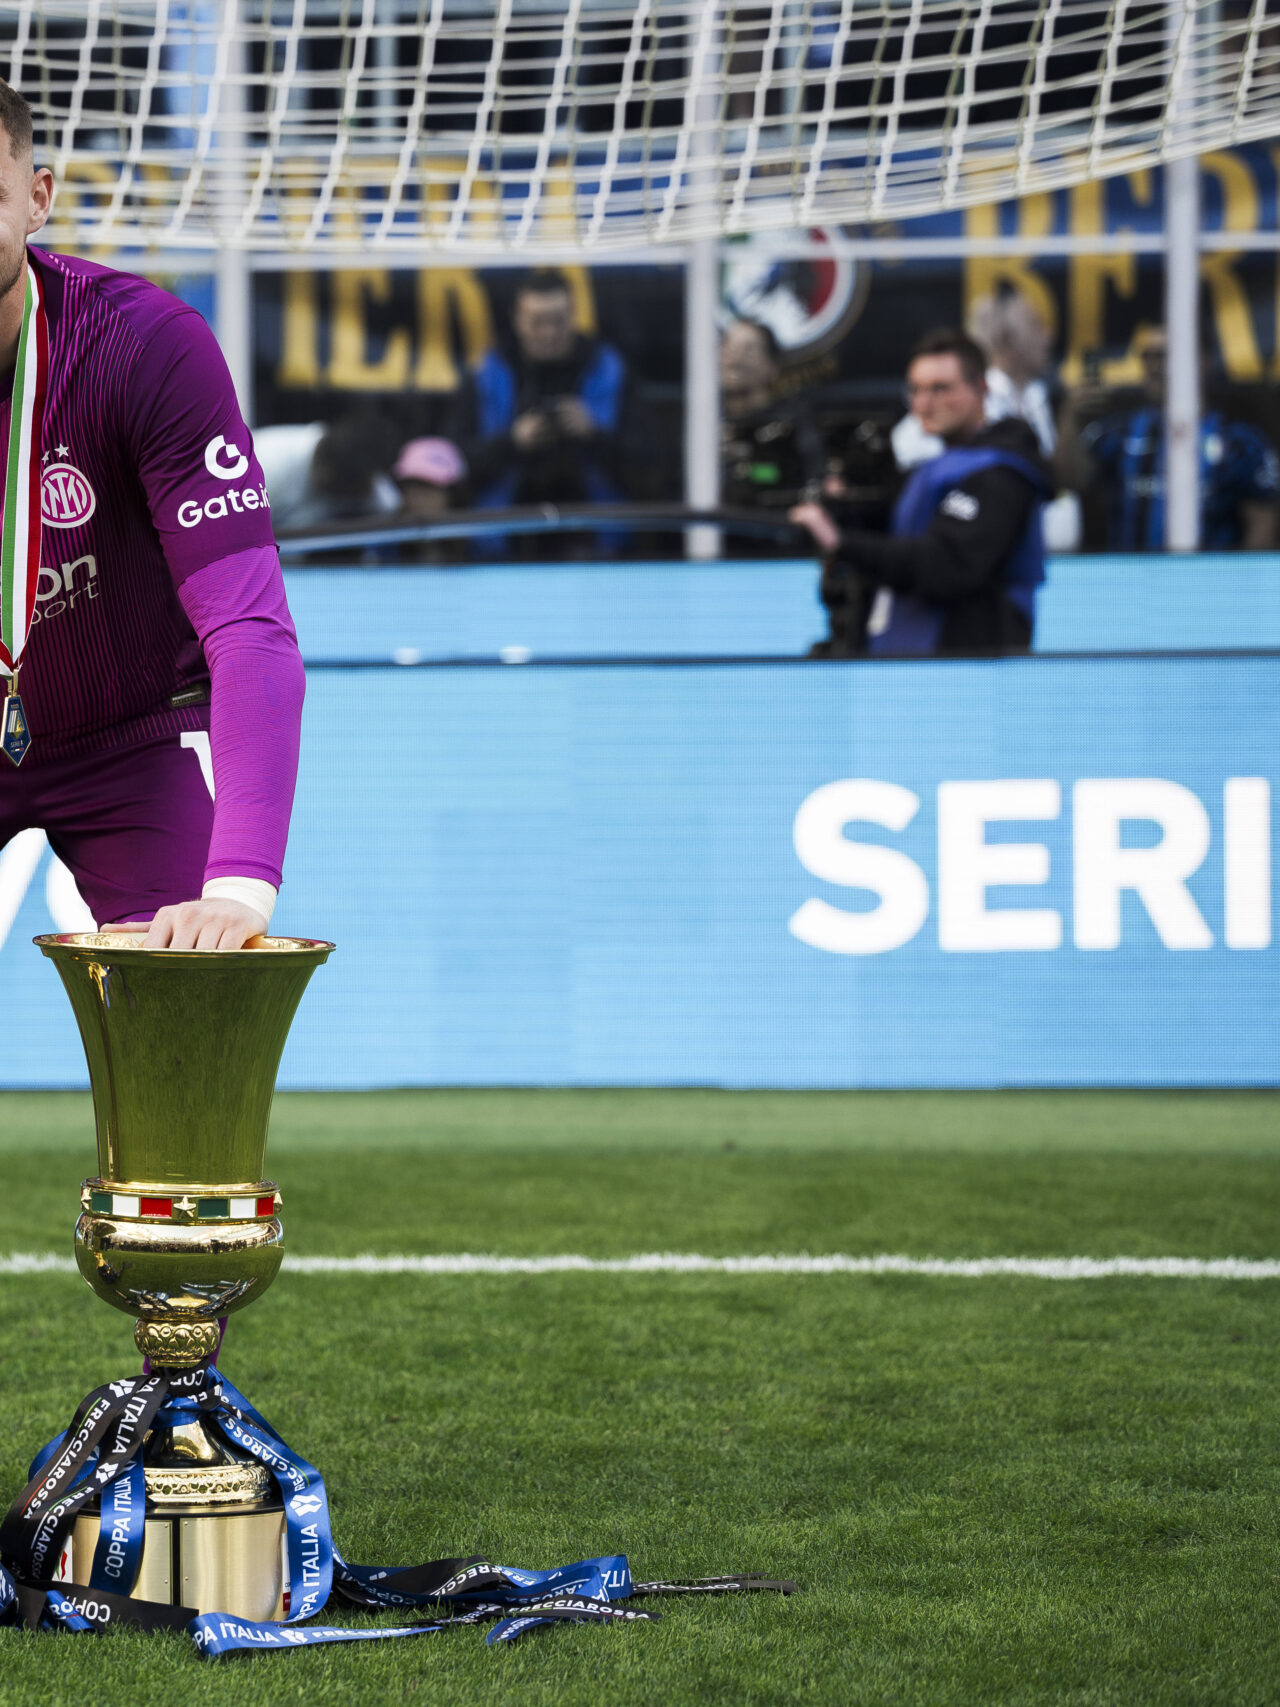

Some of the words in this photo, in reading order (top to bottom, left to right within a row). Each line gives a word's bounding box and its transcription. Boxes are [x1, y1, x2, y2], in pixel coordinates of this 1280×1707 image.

[177, 483, 271, 528] Gate.i
[111, 1396, 148, 1454] ITALIA
[22, 1397, 111, 1520] FRECCIAROSSA
[113, 1475, 133, 1513] ITALIA
[104, 1517, 131, 1579] COPPA
[300, 1523, 320, 1588] ITALIA
[219, 1622, 280, 1643] ITALIA
[508, 1600, 650, 1619] FRECCIAROSSA
